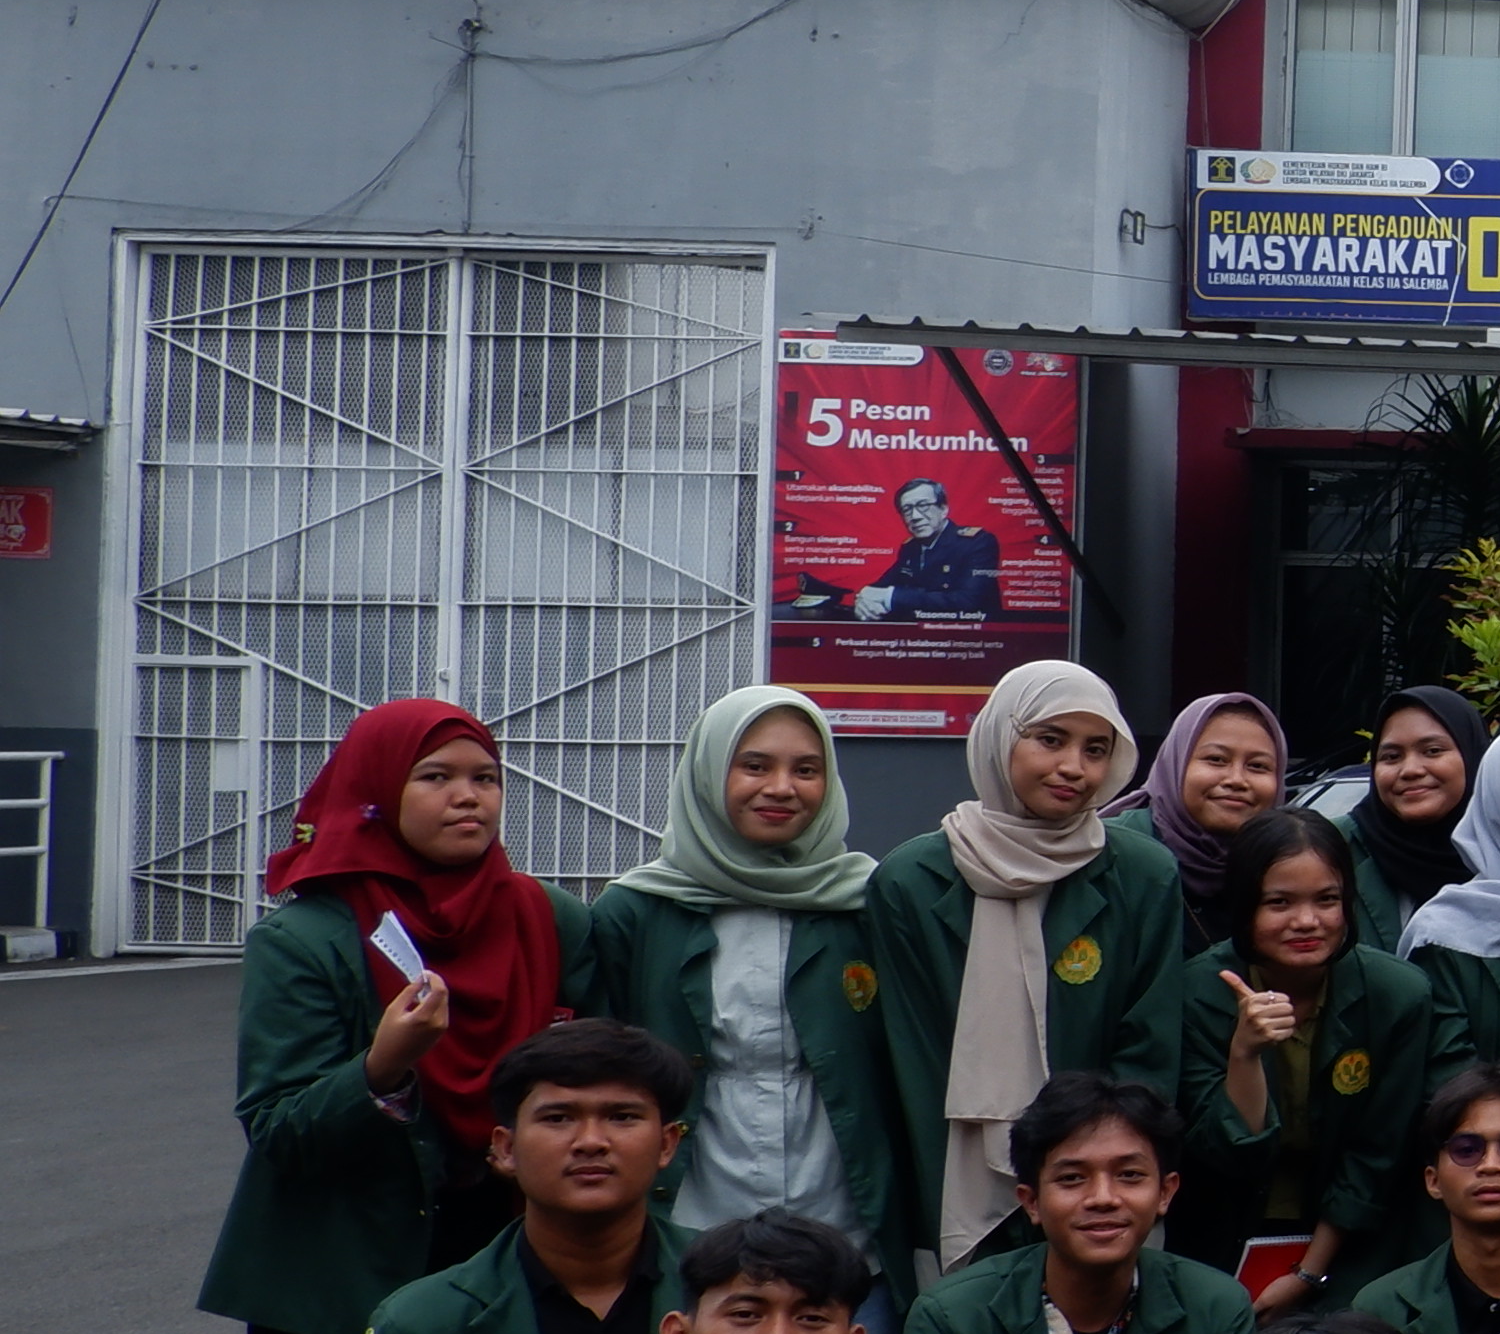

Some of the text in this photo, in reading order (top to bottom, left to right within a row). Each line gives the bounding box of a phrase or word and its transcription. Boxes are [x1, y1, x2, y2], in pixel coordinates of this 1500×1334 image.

[1210, 211, 1453, 239] PELAYANAN PENGADUAN
[1208, 234, 1453, 275] MASYARAKAT
[1208, 272, 1449, 290] LEMBAGA PEMASYARAKATAN KELAS IIA SALEMBA
[806, 398, 930, 447] 5 Pesan
[1038, 455, 1045, 464] 3
[794, 471, 800, 480] 1
[785, 522, 793, 531] 2
[1040, 535, 1048, 544] 4
[813, 638, 820, 647] 5
